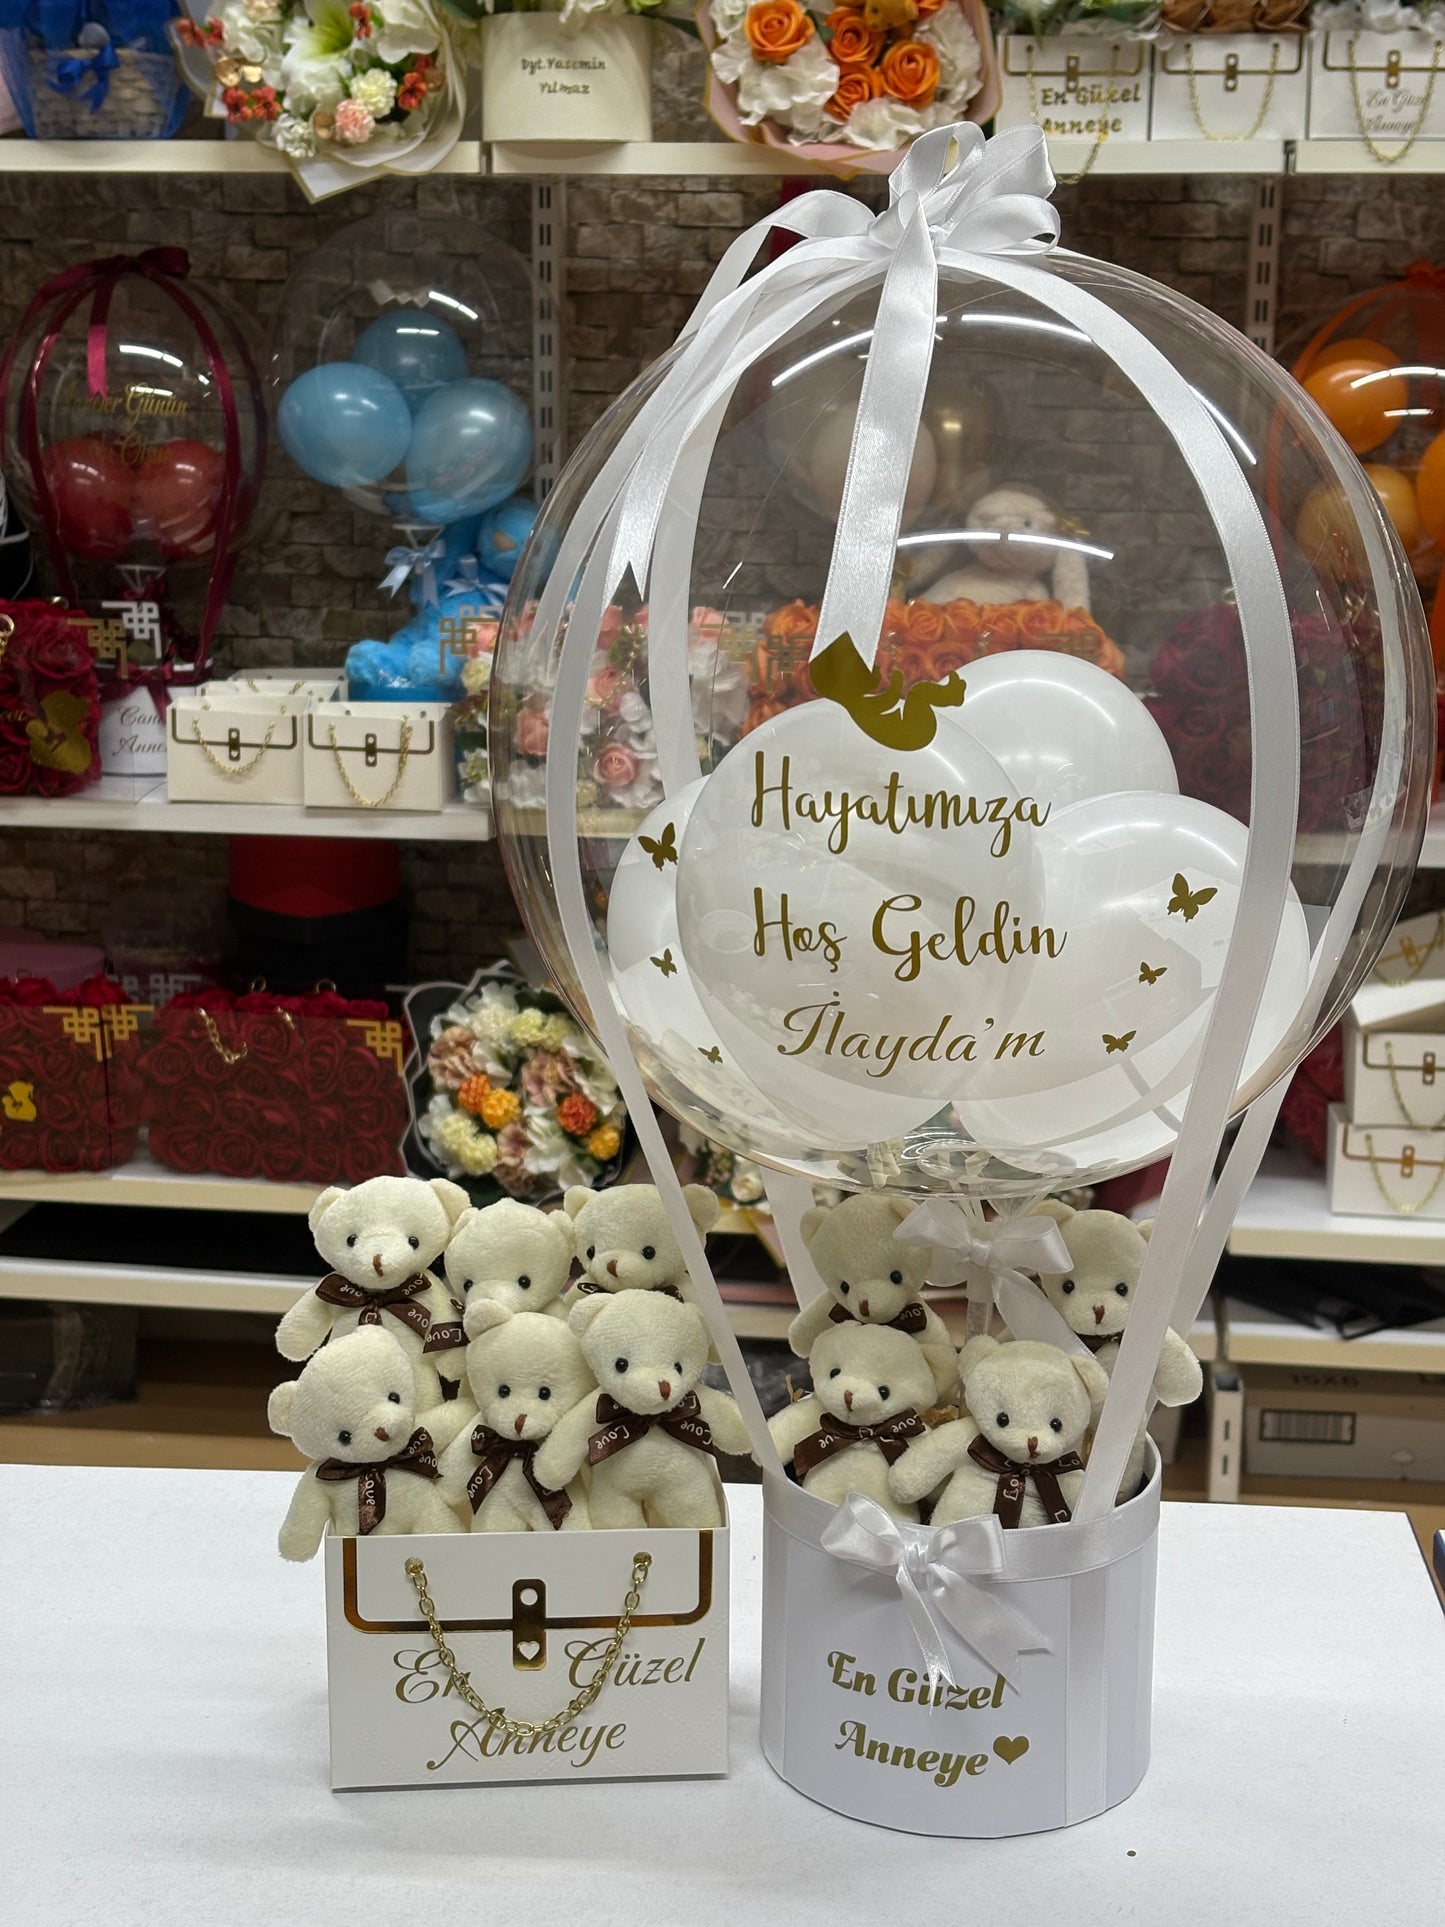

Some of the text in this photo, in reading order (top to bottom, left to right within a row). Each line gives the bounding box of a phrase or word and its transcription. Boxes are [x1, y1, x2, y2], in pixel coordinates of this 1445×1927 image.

[1041, 88, 1067, 105] En
[751, 751, 1052, 858] Hayatımıza
[753, 887, 1068, 982] Hoş Geldin
[407, 1308, 429, 1328] ove
[426, 1328, 462, 1343] Love
[595, 1425, 631, 1449] Love
[681, 1420, 713, 1446] Love
[419, 1453, 438, 1468] ove
[467, 1465, 494, 1499] Love
[564, 1637, 706, 1709] Güzel
[827, 1650, 1006, 1711] En Güzel
[427, 1707, 628, 1770] Anneye
[834, 1719, 990, 1788] Anneye
